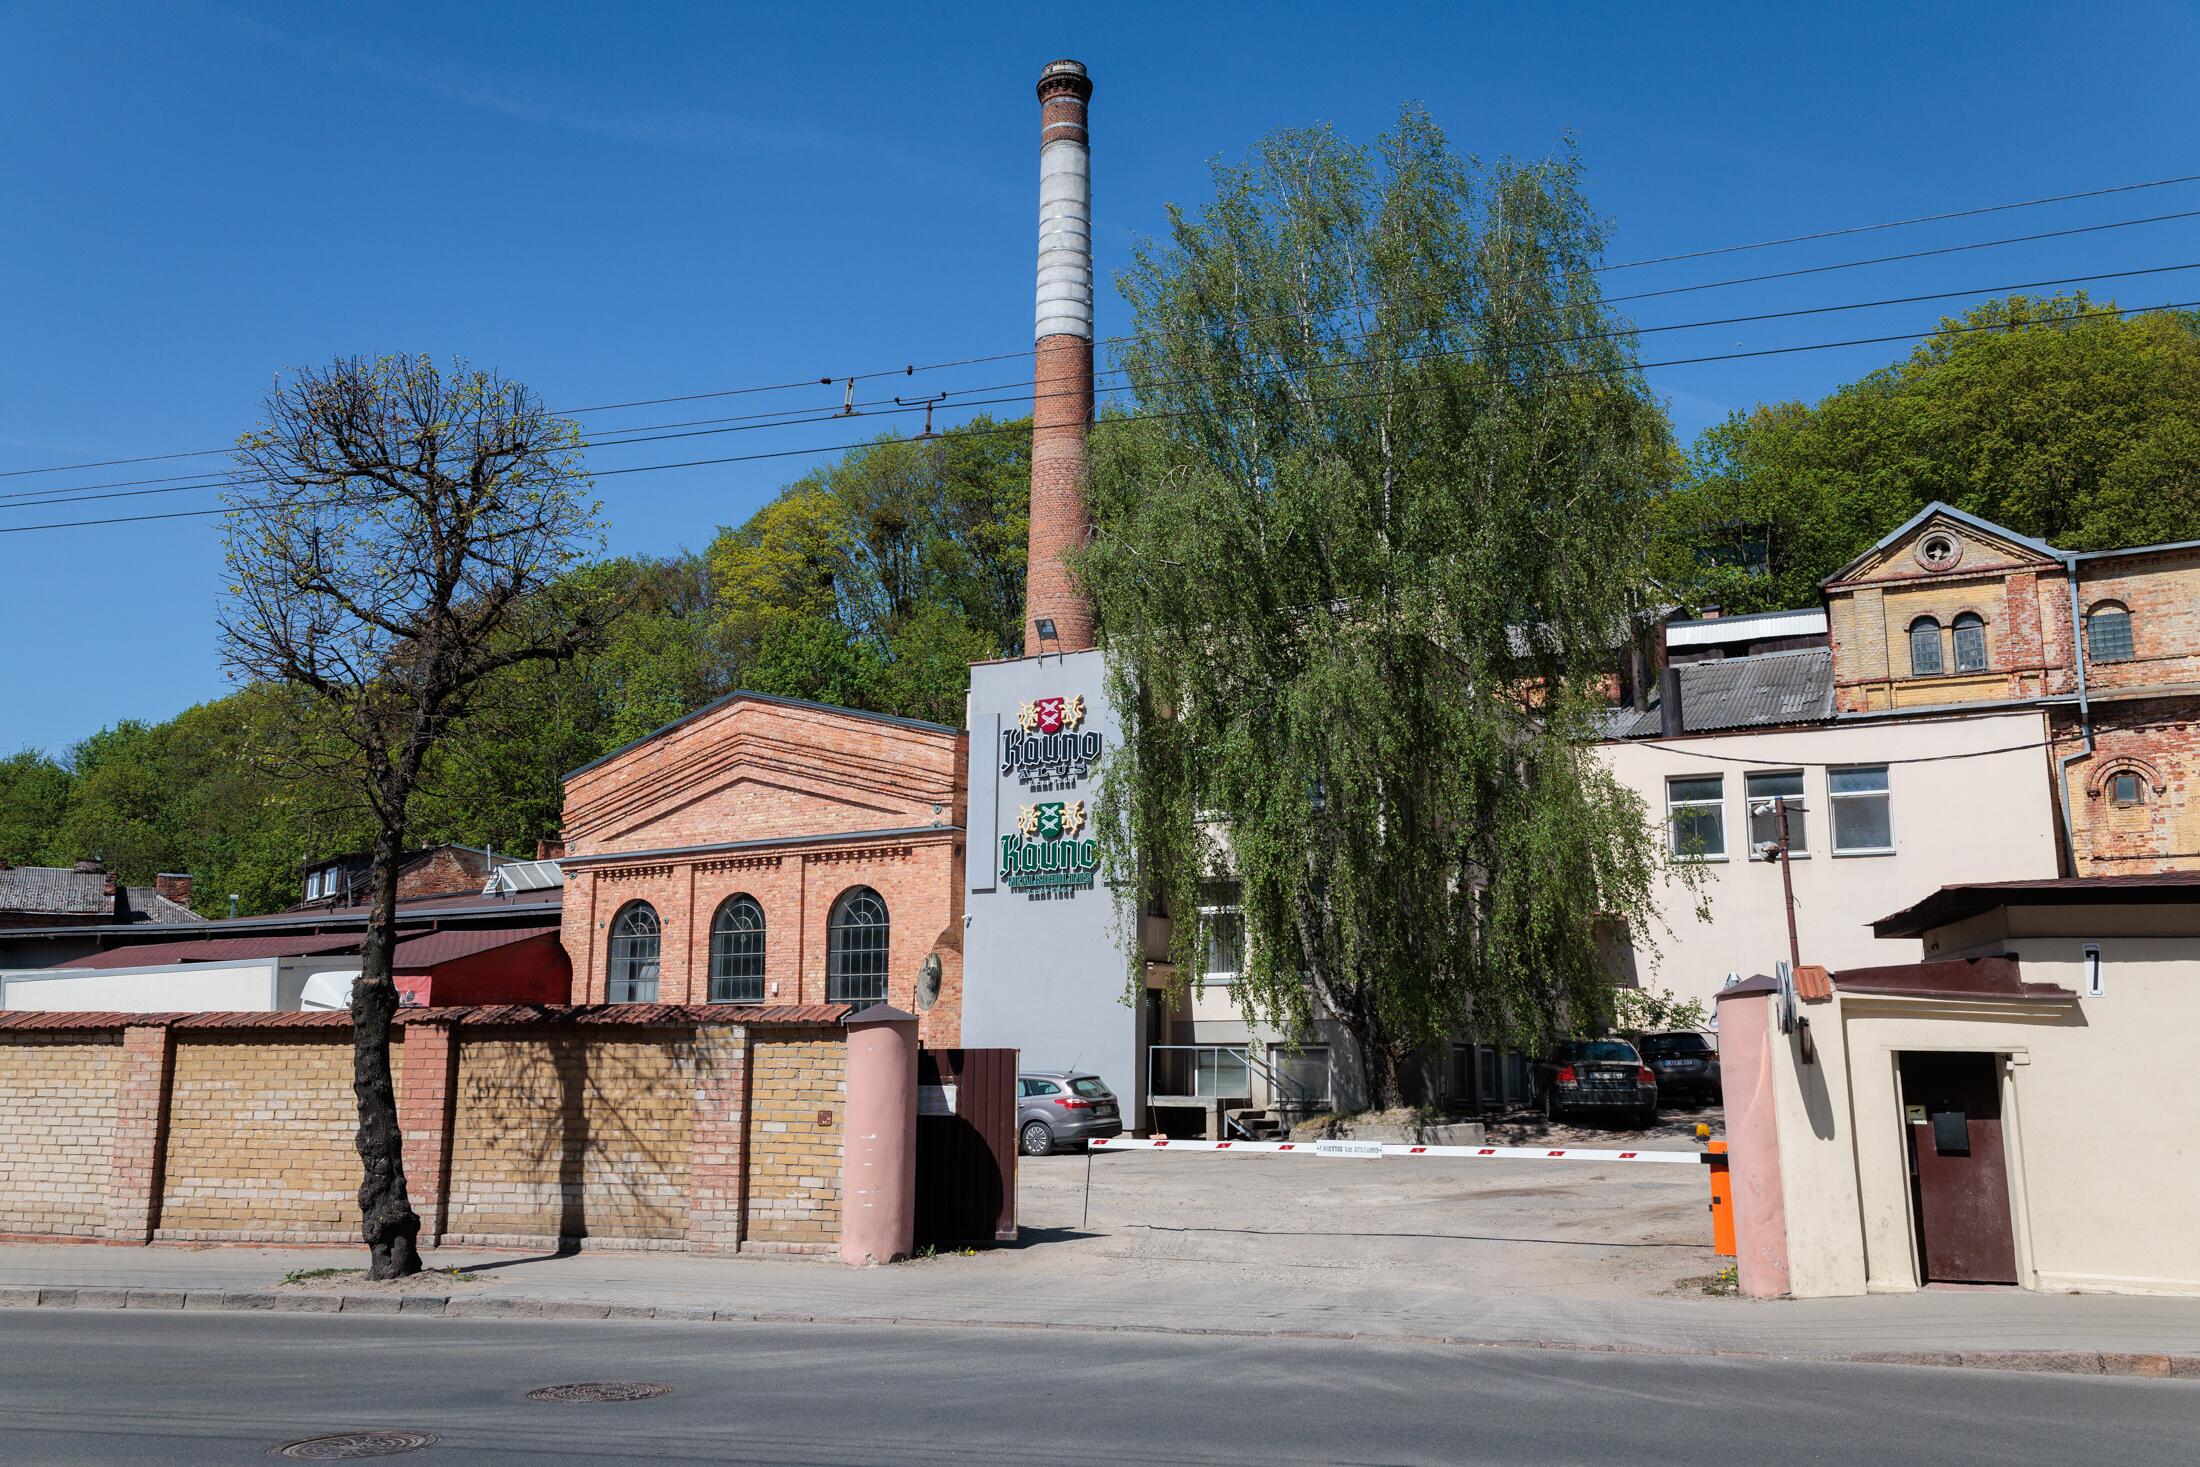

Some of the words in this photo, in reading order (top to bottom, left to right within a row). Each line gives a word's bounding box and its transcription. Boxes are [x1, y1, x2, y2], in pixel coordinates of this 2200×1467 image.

[1000, 728, 1100, 772] Kauno
[1018, 763, 1087, 778] ALUS
[1000, 833, 1098, 878] Kauno
[2085, 950, 2099, 990] 7
